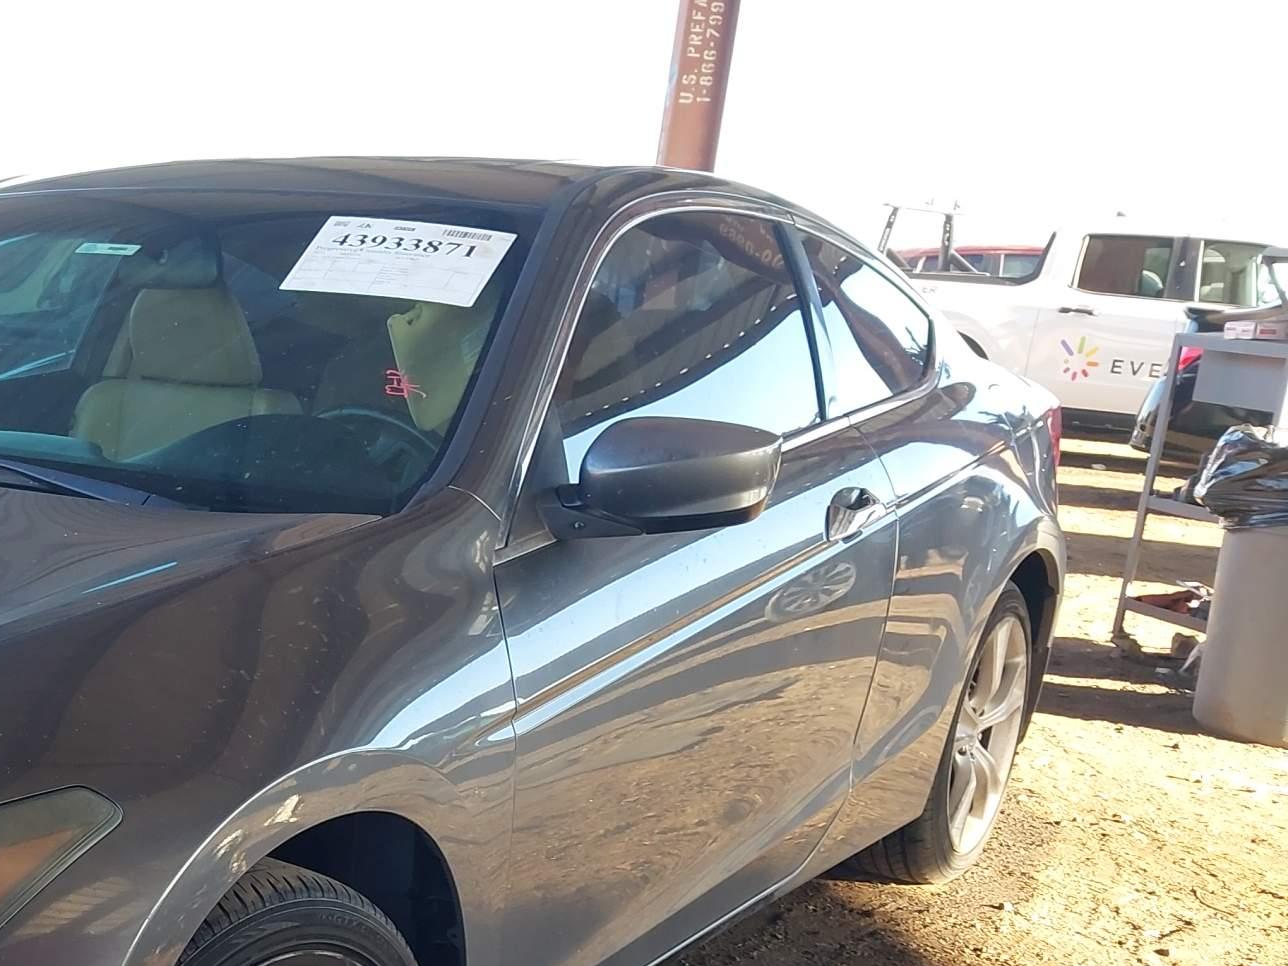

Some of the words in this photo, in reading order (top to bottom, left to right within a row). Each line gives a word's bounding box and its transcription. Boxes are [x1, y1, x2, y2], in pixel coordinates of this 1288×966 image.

[678, 69, 698, 104] U.S.
[332, 233, 477, 258] 43933871
[1110, 359, 1168, 378] EVE
